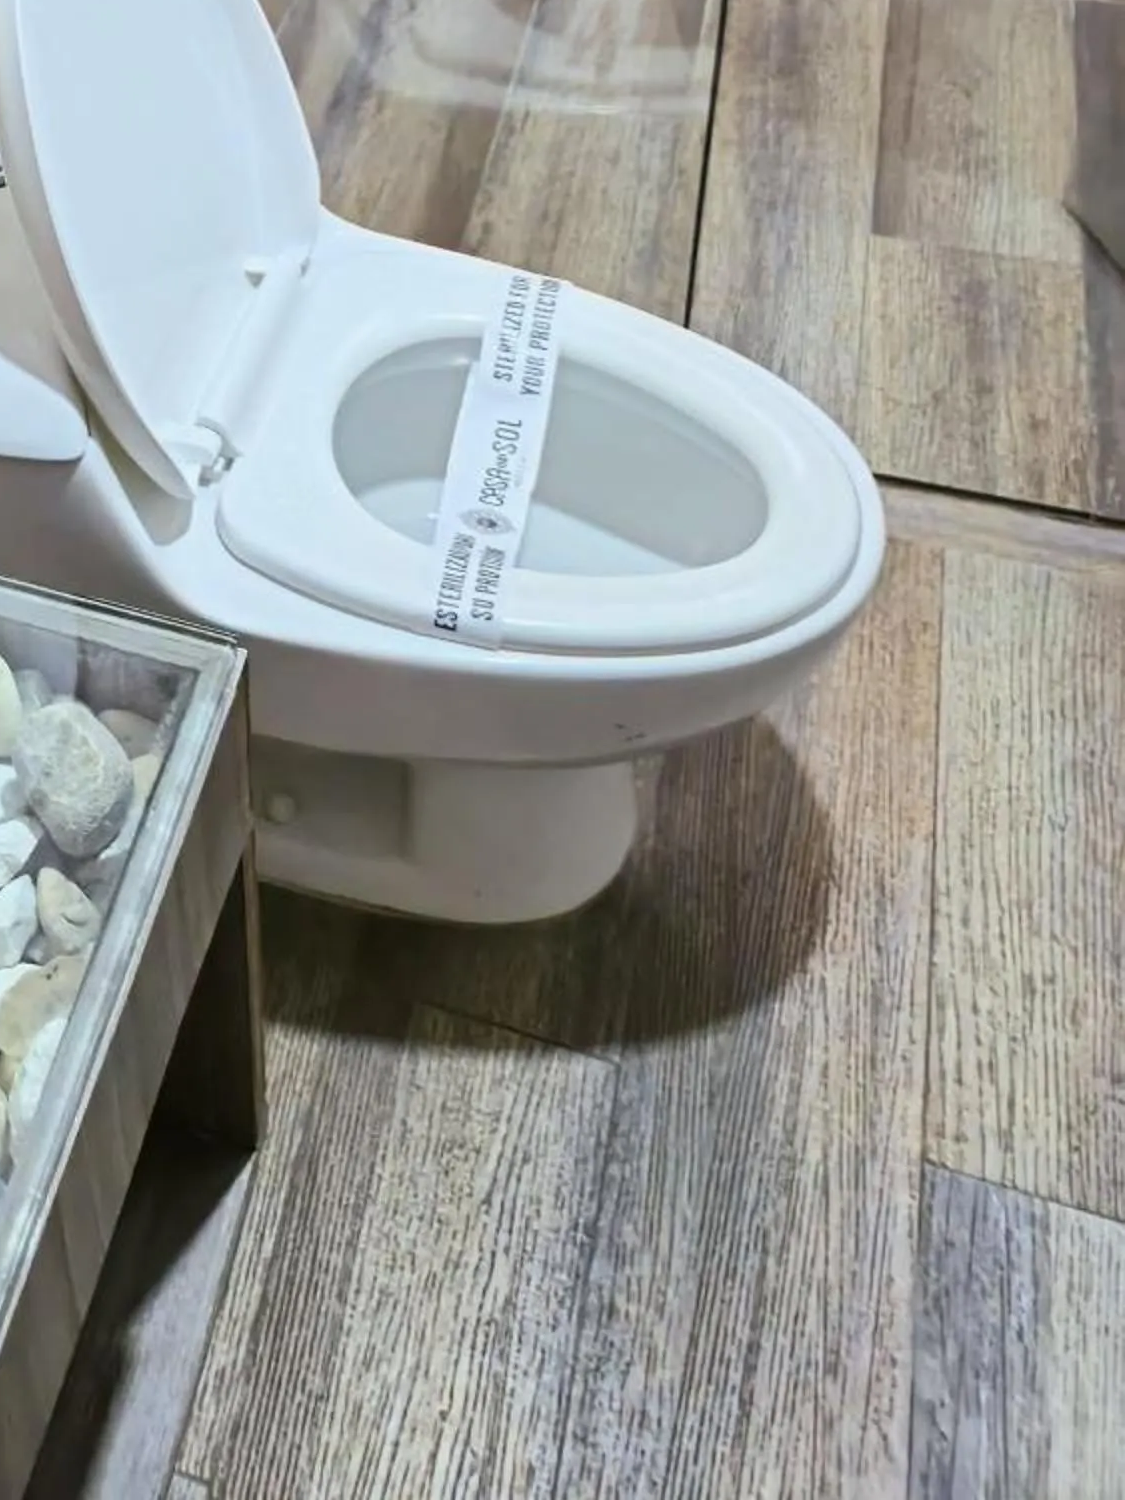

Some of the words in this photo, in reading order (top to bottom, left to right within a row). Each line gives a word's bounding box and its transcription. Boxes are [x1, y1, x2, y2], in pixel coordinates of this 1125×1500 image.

[519, 355, 544, 395] YOUR
[490, 419, 522, 456] SOL
[478, 467, 511, 507] CASA
[471, 596, 495, 621] SU
